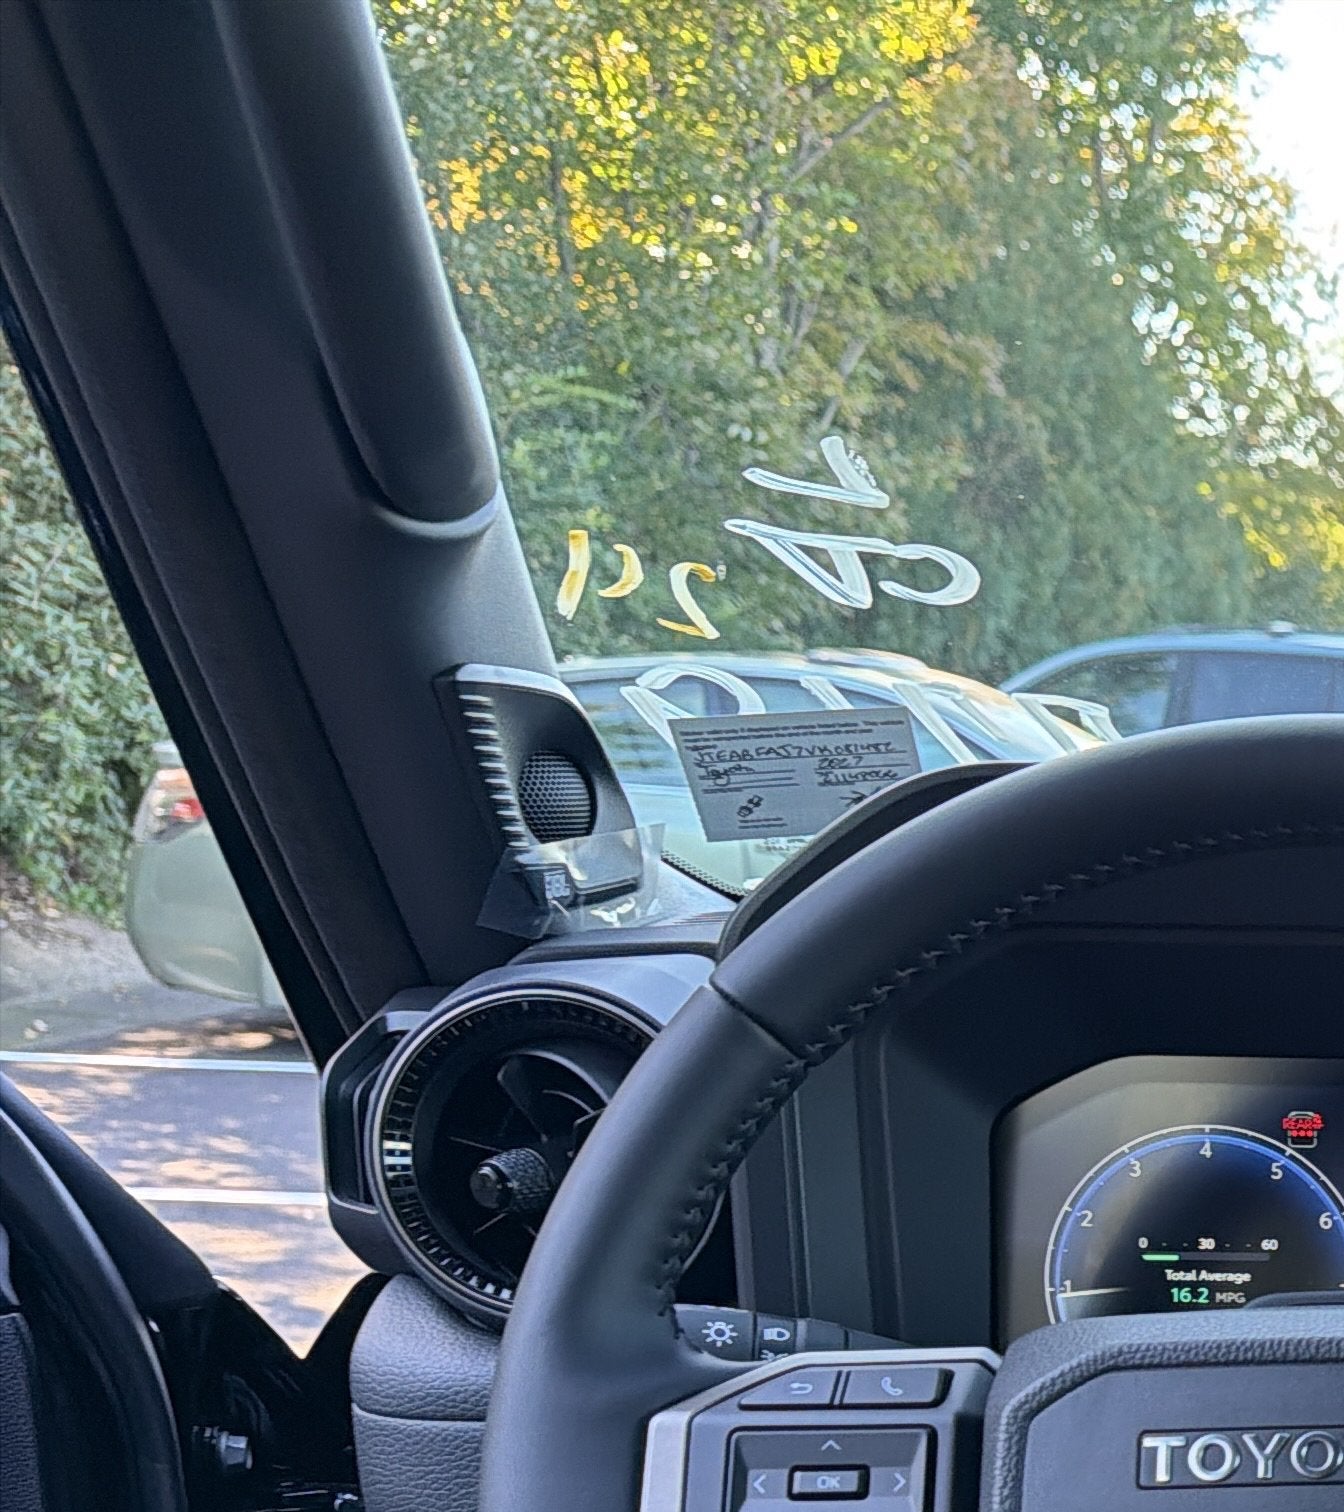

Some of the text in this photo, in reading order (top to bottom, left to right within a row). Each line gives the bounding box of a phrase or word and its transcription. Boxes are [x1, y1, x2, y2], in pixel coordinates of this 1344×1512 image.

[1200, 1142, 1213, 1159] 4
[1129, 1160, 1142, 1178] 3
[1270, 1162, 1283, 1180] 5
[1080, 1210, 1094, 1228] 2
[1319, 1213, 1333, 1230] 6
[1138, 1237, 1279, 1252] 0 30 60
[1164, 1269, 1252, 1285] Total Average
[1170, 1287, 1246, 1304] 16.2 MPG
[816, 1476, 841, 1489] OK
